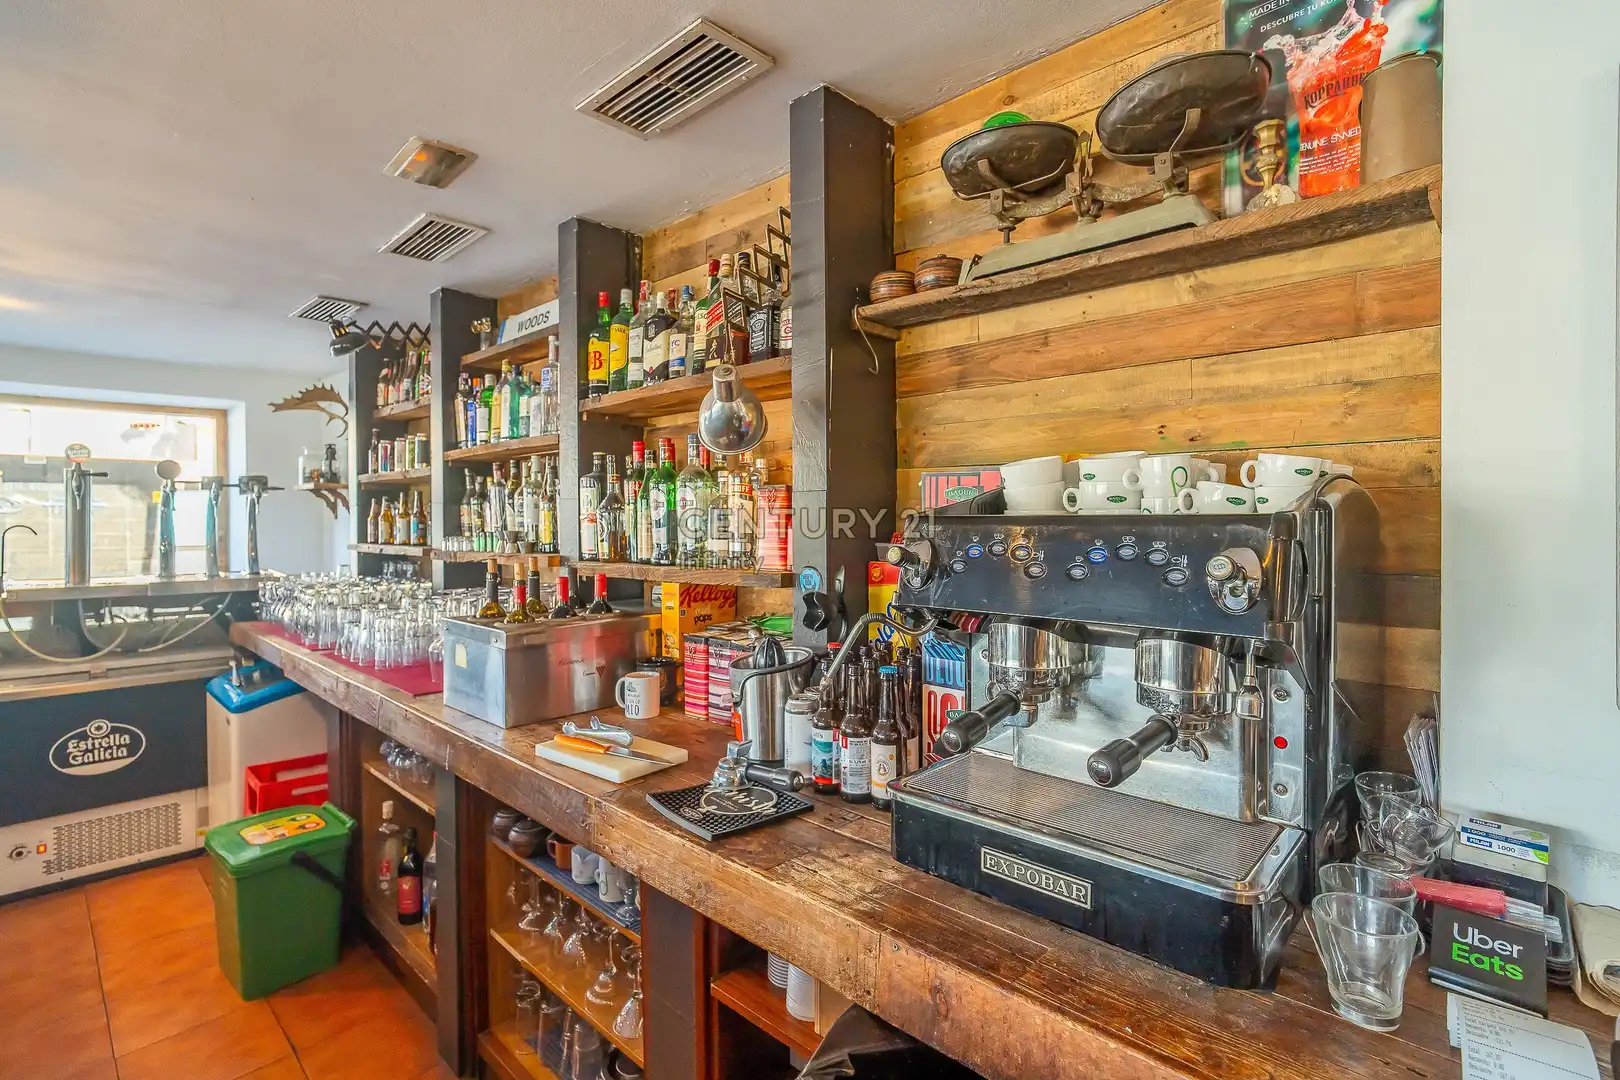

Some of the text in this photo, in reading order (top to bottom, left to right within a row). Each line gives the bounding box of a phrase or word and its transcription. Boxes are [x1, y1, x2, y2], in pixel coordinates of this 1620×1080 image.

[1249, 1, 1279, 18] MADE
[1260, 9, 1306, 33] DESCUBRE
[1303, 72, 1368, 109] KOPPARBE
[1330, 126, 1361, 144] SWED
[517, 311, 550, 333] WOODS
[66, 733, 131, 753] Estrella
[69, 745, 128, 765] Galicia
[1467, 828, 1486, 837] 1000
[1497, 844, 1516, 853] 1000
[985, 854, 1087, 902] EXPOBAR
[1452, 923, 1524, 958] Uber
[1452, 942, 1524, 981] Eats
